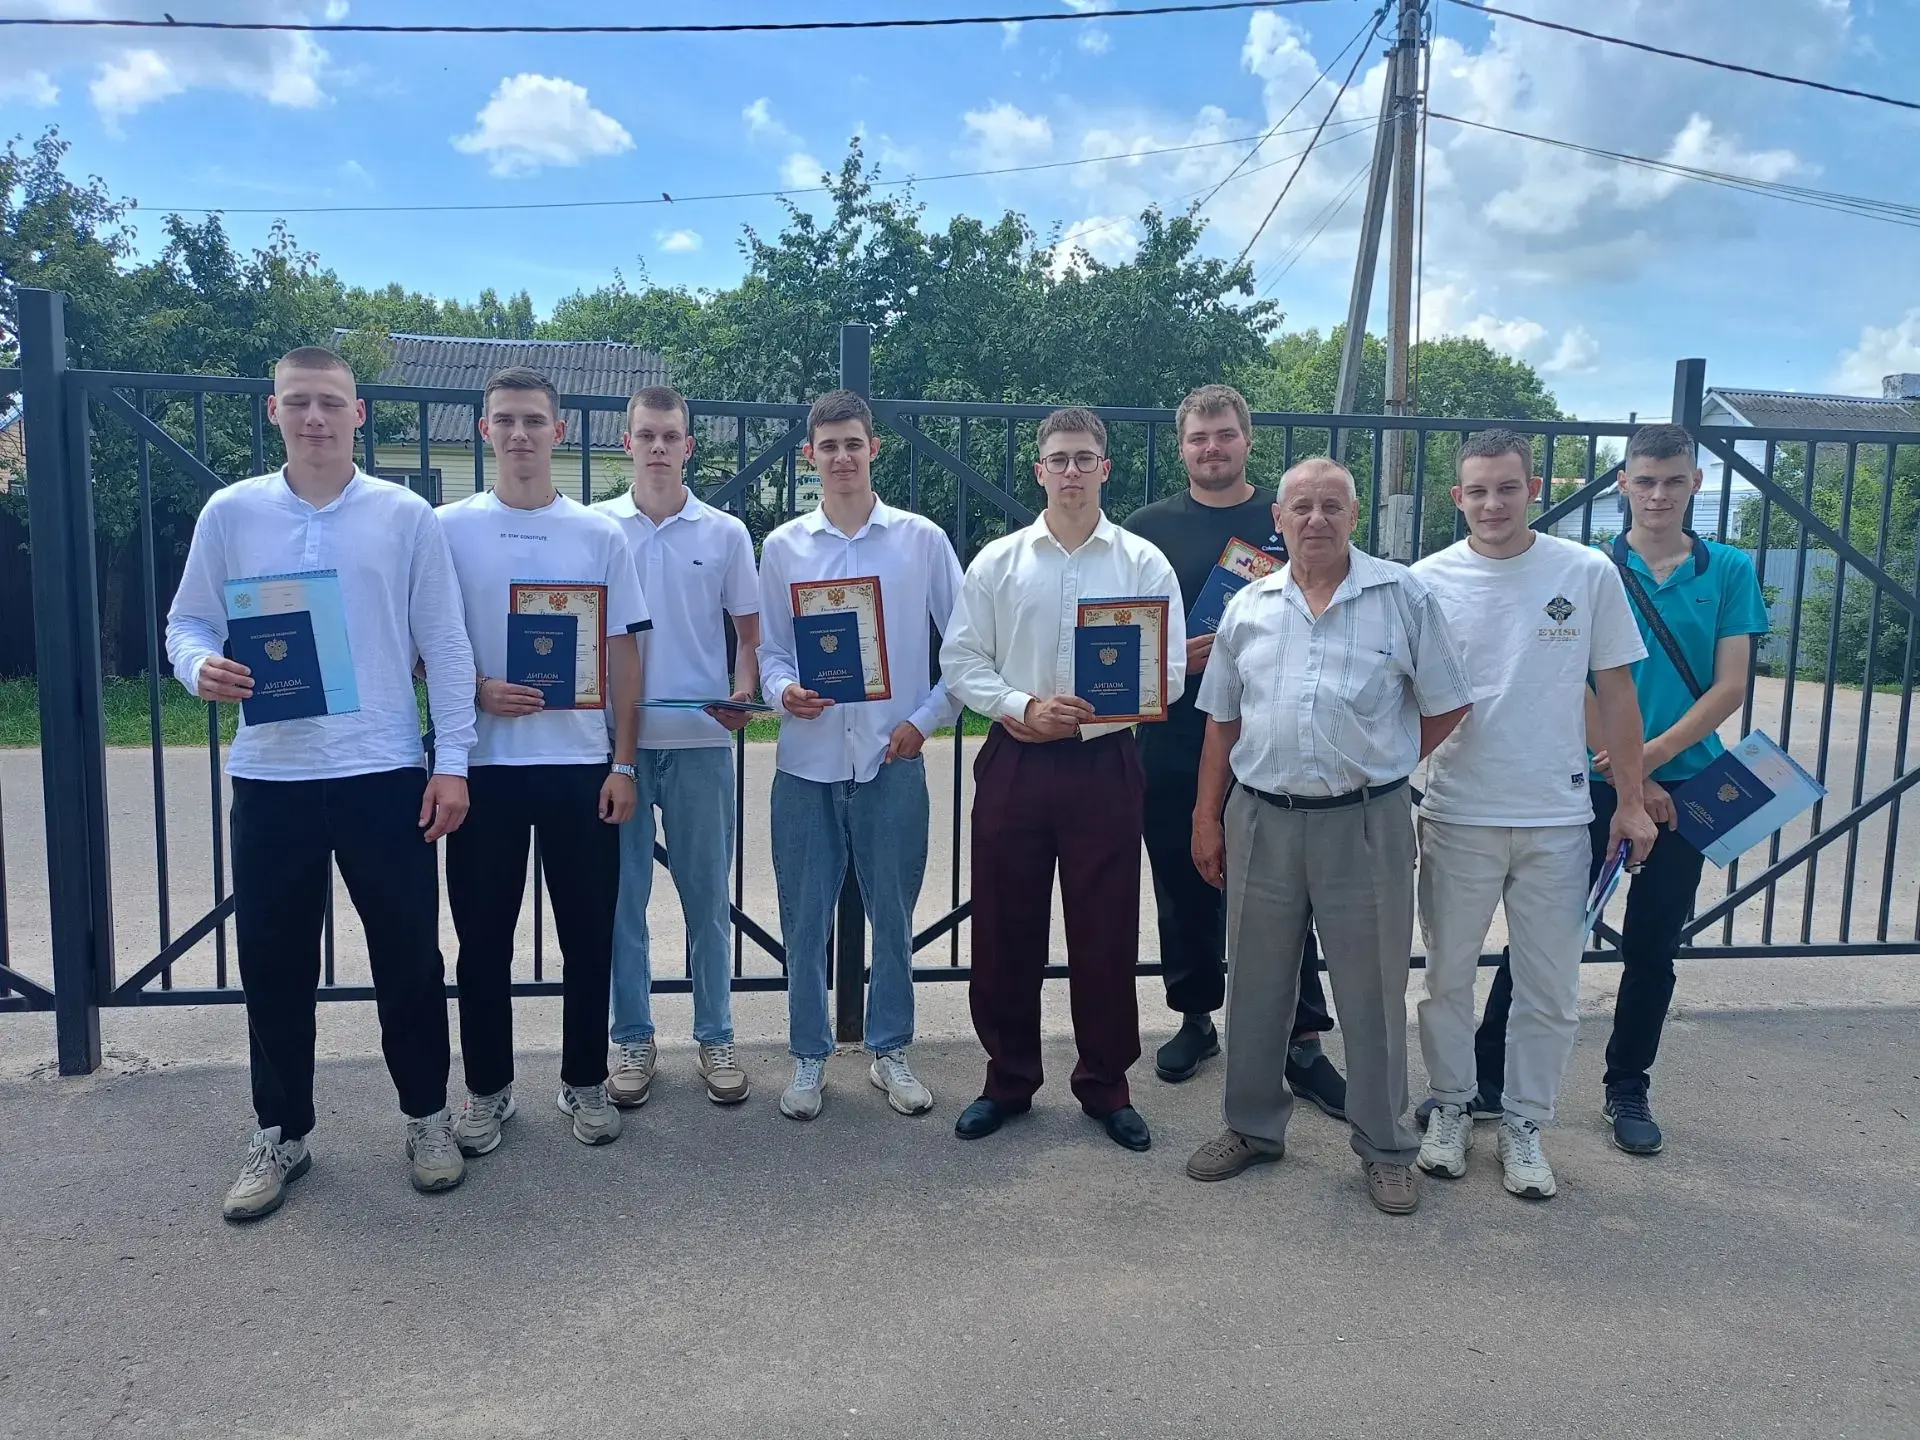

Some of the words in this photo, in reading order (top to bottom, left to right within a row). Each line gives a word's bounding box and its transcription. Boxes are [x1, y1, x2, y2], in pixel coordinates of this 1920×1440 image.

[1538, 628, 1581, 636] EVISU
[526, 672, 559, 680] ДИПЛОМ
[817, 668, 848, 678] ДИПЛОМ
[264, 678, 303, 691] ДИПЛОМ
[1093, 681, 1124, 689] ДИПЛОМ
[1689, 801, 1716, 825] ДИПЛОМ
